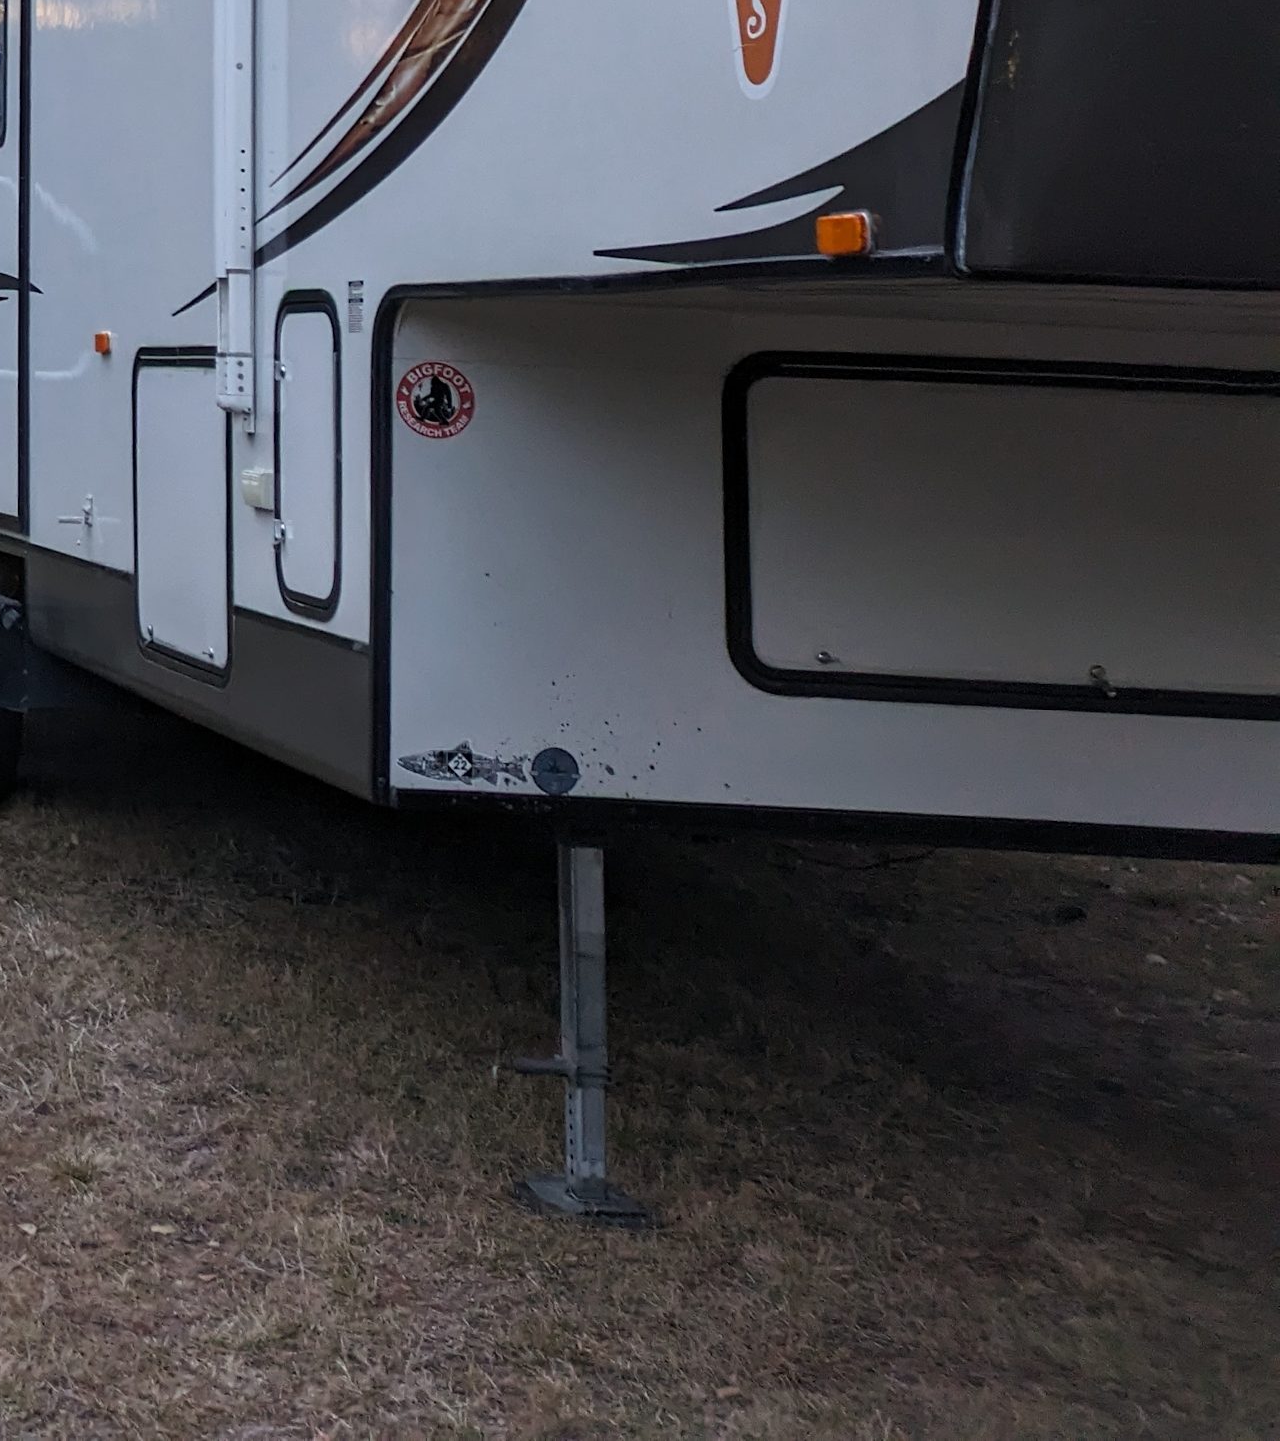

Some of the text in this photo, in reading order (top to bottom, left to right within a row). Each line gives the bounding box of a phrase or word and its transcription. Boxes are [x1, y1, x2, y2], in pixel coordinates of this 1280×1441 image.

[406, 363, 472, 394] BIGFOOT
[398, 400, 470, 437] RESEARCH TEAM
[453, 759, 468, 770] 22
